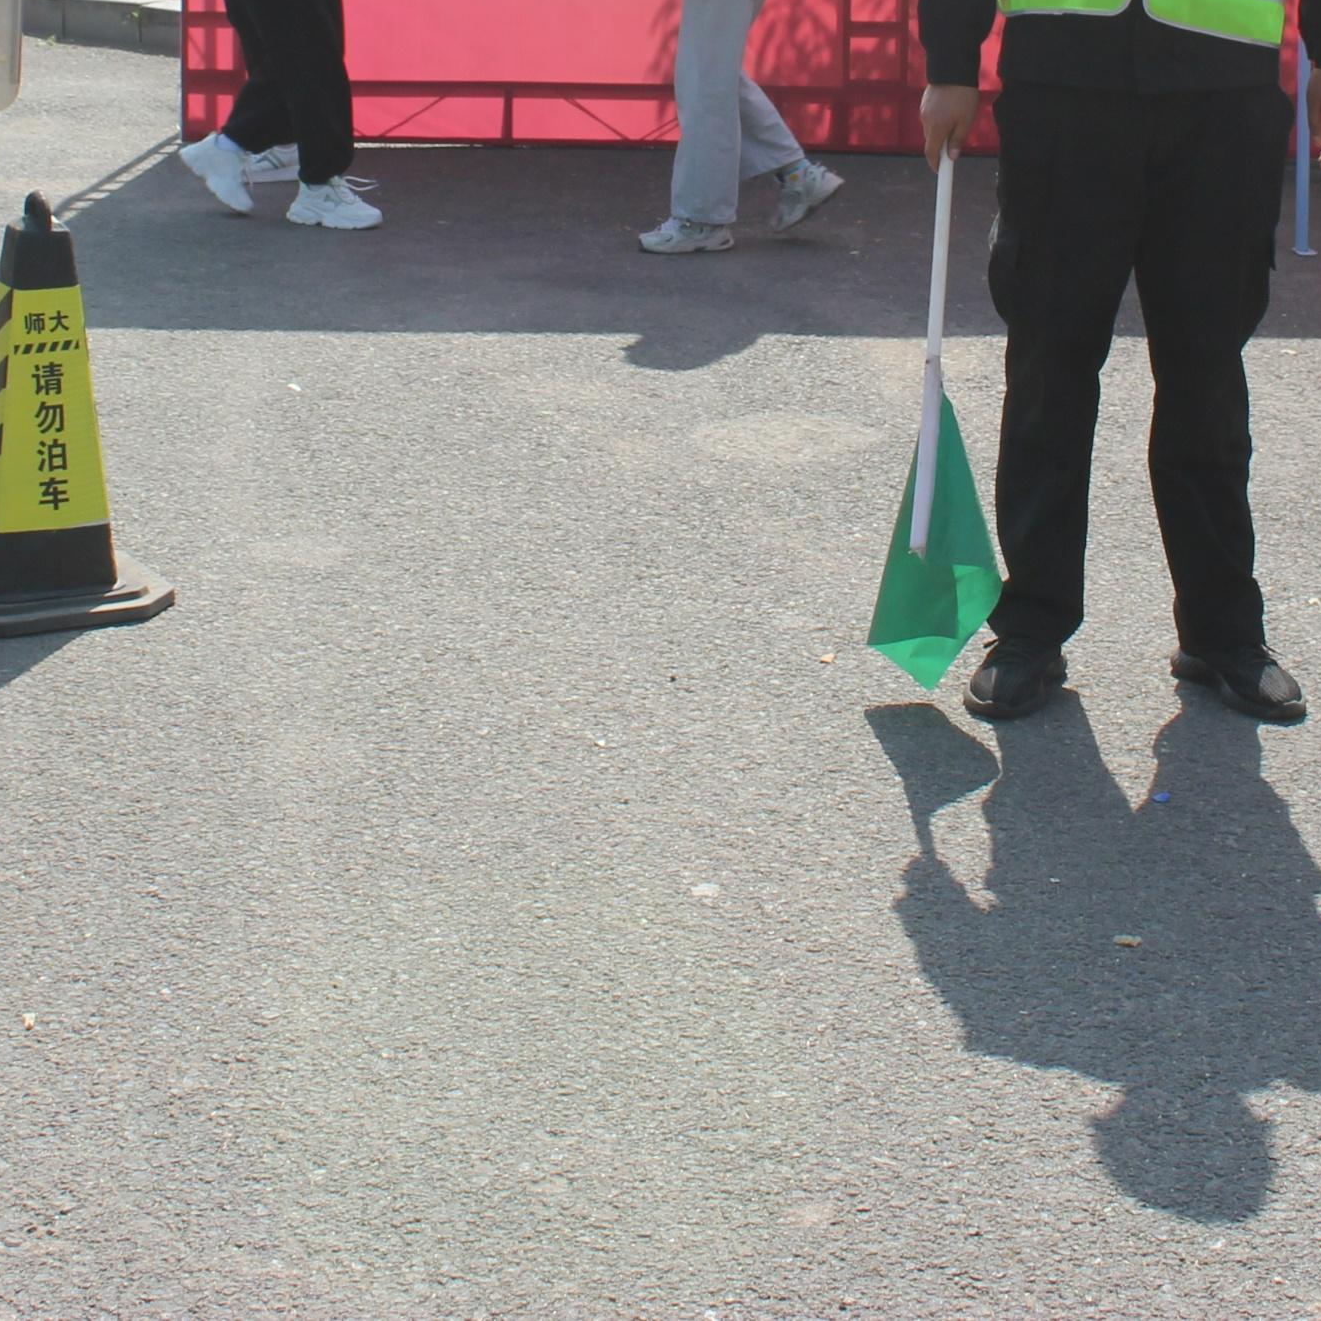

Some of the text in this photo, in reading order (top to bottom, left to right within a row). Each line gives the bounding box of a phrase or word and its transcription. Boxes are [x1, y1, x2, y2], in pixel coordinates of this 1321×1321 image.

[23, 309, 70, 335] 师大
[31, 361, 70, 512] 请勿泊车
